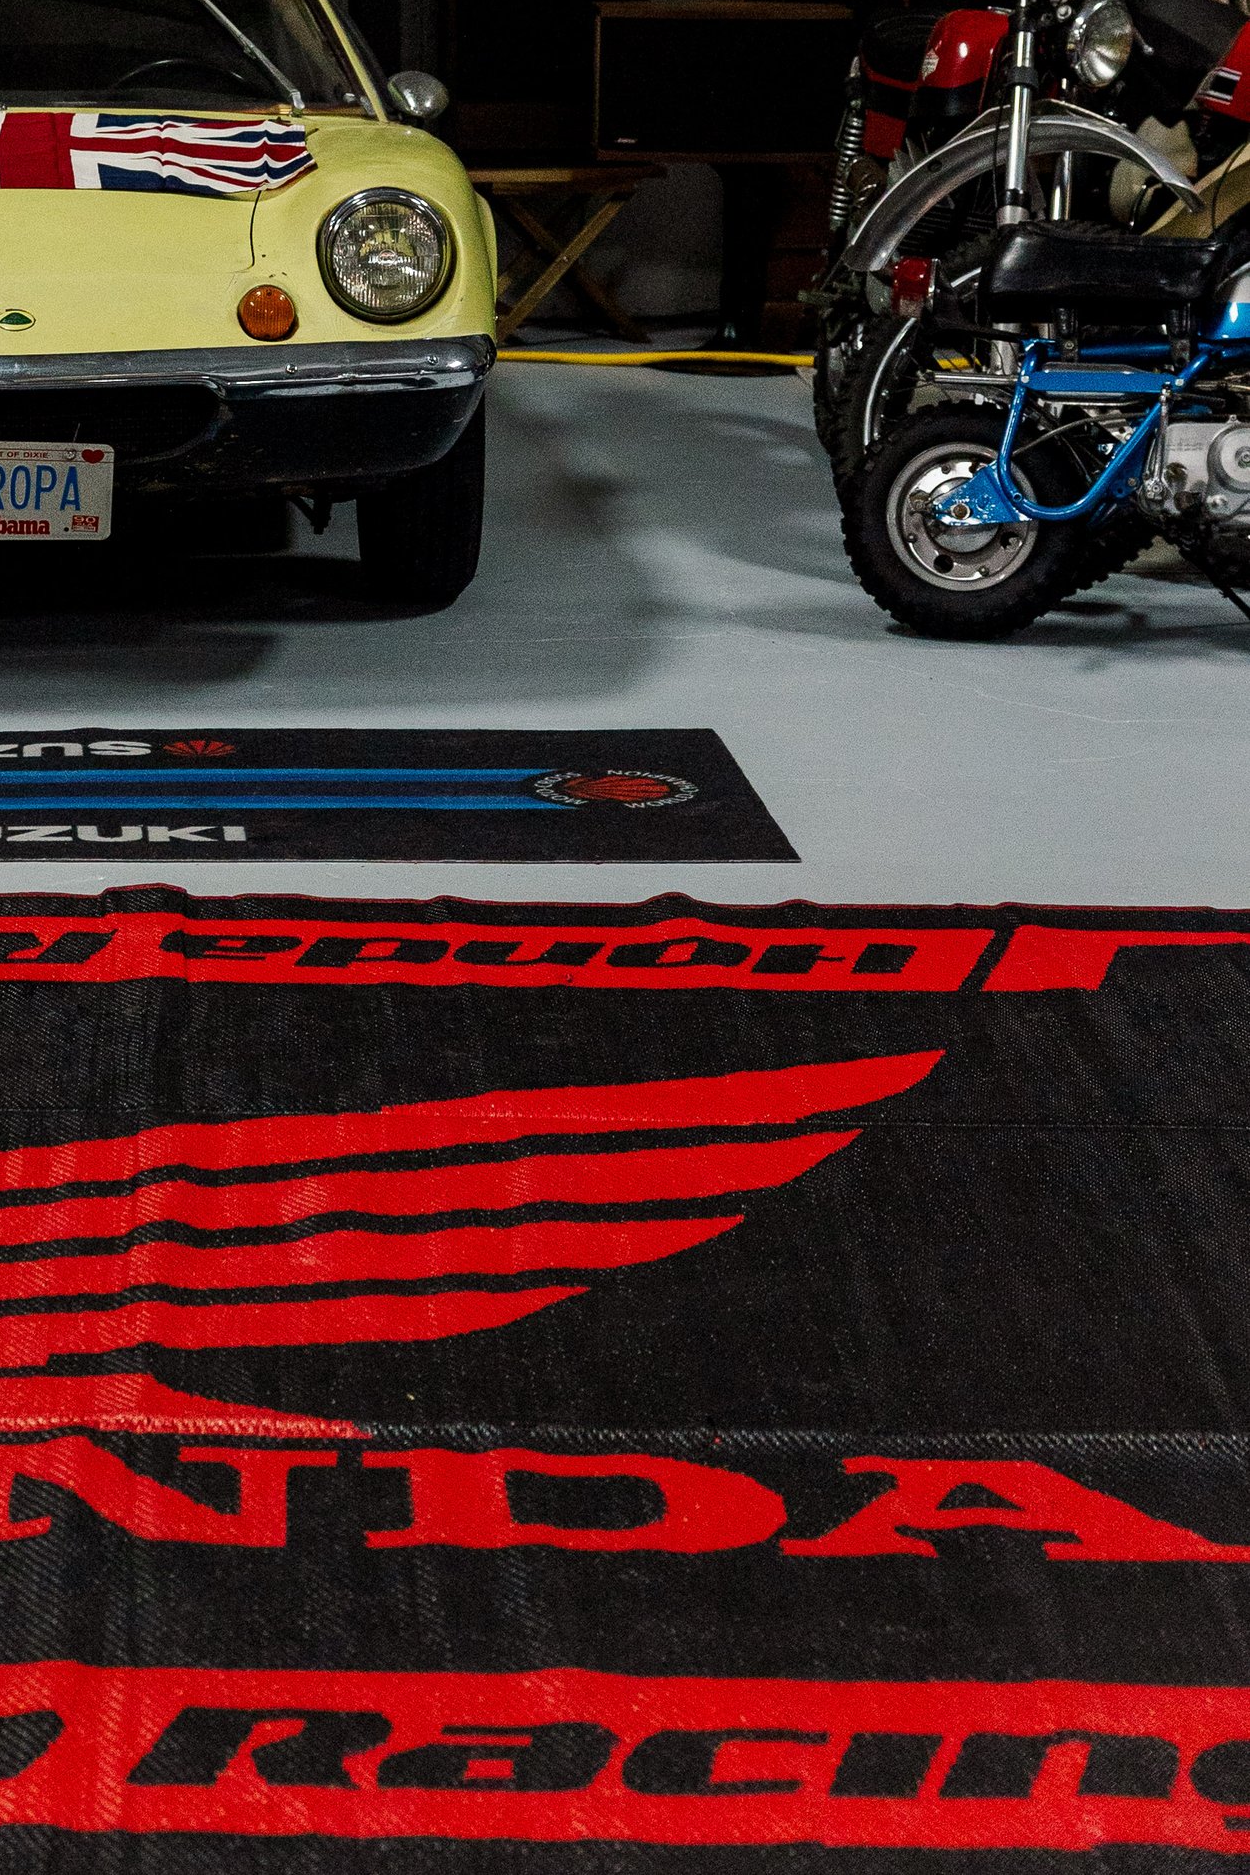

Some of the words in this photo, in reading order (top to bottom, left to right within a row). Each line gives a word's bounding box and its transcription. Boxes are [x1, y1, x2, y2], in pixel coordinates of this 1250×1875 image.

[7, 451, 20, 459] OF
[23, 451, 49, 460] DIXIE
[158, 930, 918, 975] Honda
